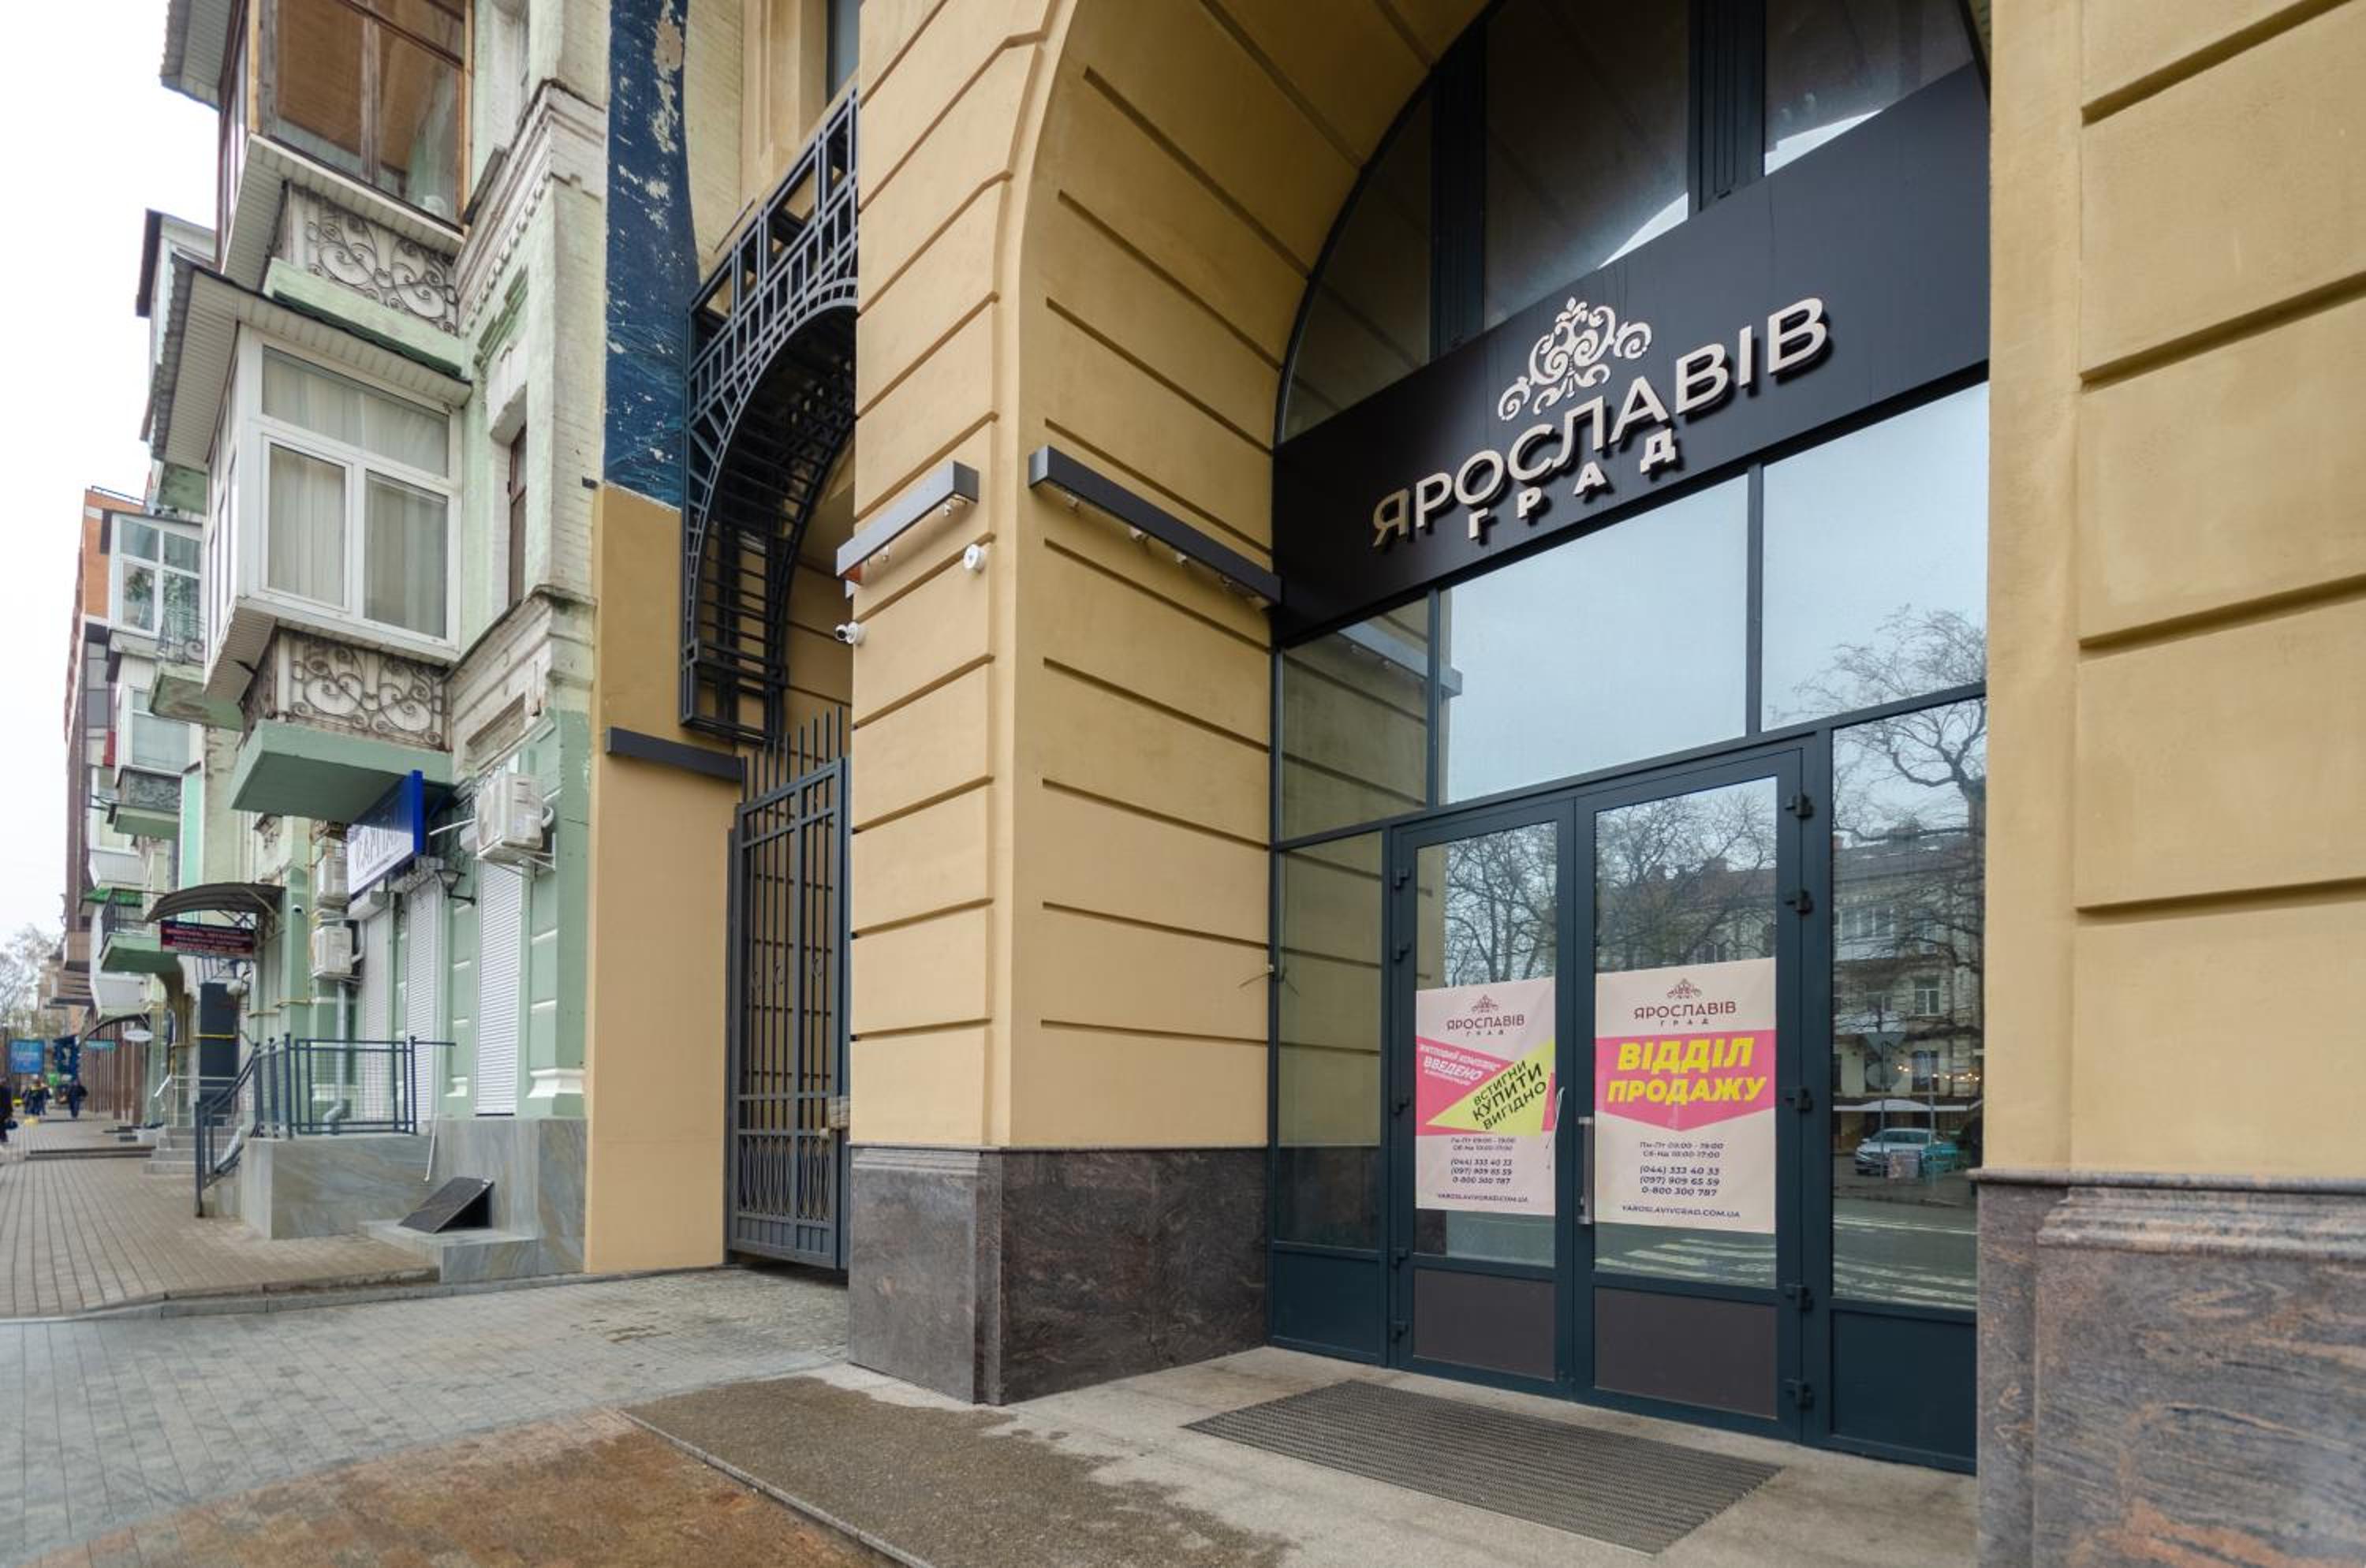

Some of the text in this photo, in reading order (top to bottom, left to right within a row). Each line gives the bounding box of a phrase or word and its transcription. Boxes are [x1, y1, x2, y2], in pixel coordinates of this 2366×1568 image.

[1373, 297, 1828, 547] ЯРОСЛАВІВ
[1468, 428, 1677, 539] ГРАД
[1446, 1014, 1524, 1030] ЯРОСЛАВІВ
[1634, 1001, 1736, 1019] ЯРОСЛАВІВ
[1424, 1055, 1483, 1081] ВВЕДЕНО
[1618, 1037, 1755, 1073] ВІДДІЛ
[1472, 1062, 1542, 1122] КУПИТИ
[1474, 1059, 1527, 1106] ВСТИГНИ
[1607, 1077, 1767, 1106] ПРОДАЖУ
[1483, 1081, 1547, 1130] ВИГІДНО
